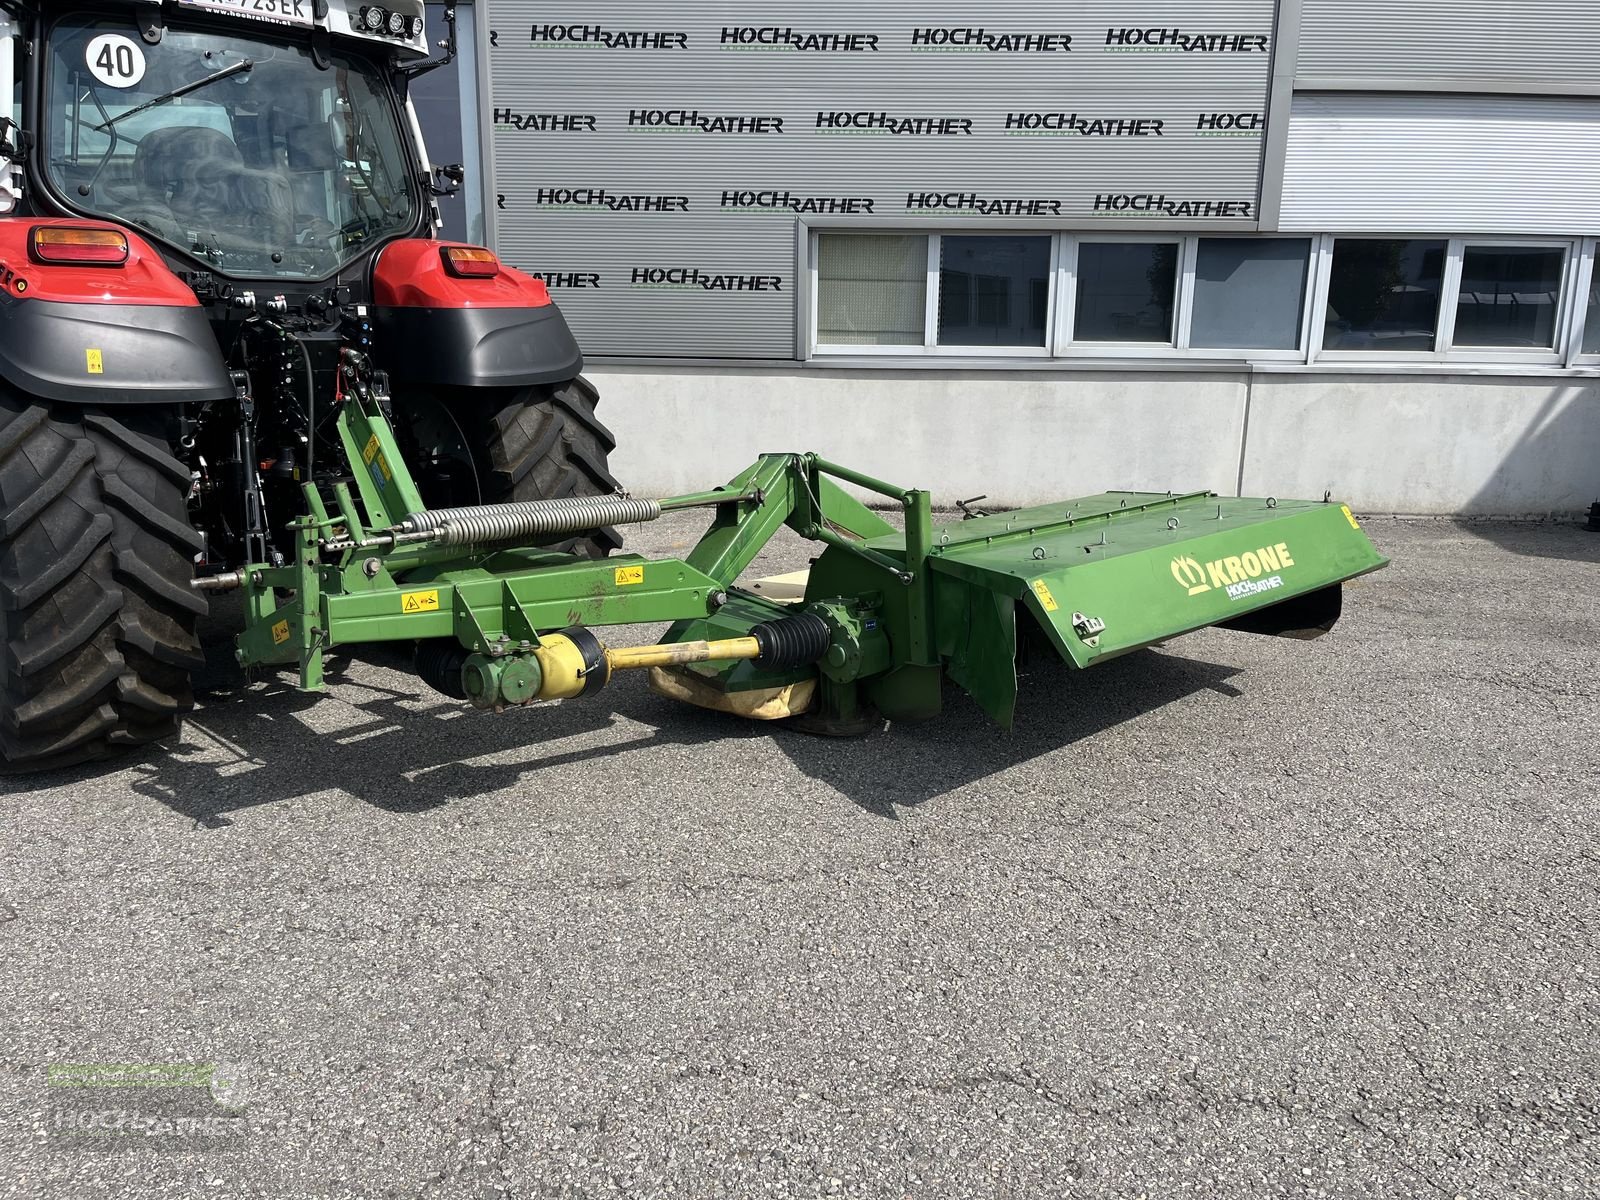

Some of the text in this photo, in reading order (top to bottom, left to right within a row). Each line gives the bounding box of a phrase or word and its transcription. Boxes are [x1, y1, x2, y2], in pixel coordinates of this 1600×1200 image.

[531, 25, 688, 48] HOCHRATHER
[721, 28, 878, 50] HOCHRATHER
[912, 29, 1071, 51] HOCHRATHER
[1106, 29, 1267, 51] HOCHRATHER
[96, 43, 135, 78] 40
[629, 110, 783, 133] HOCHRATHER
[816, 112, 972, 134] HOCHRATHER
[1005, 114, 1163, 135] HOCHRATHER
[537, 189, 688, 211] HOCHRATHER
[721, 191, 873, 213] HOCHRATHER
[907, 193, 1060, 215] HOCHRATHER
[1094, 195, 1251, 217] HOCHRATHER
[632, 268, 781, 291] HOCHRATHER
[1205, 542, 1294, 588] KRONE
[1225, 576, 1284, 598] HOCHRATHER
